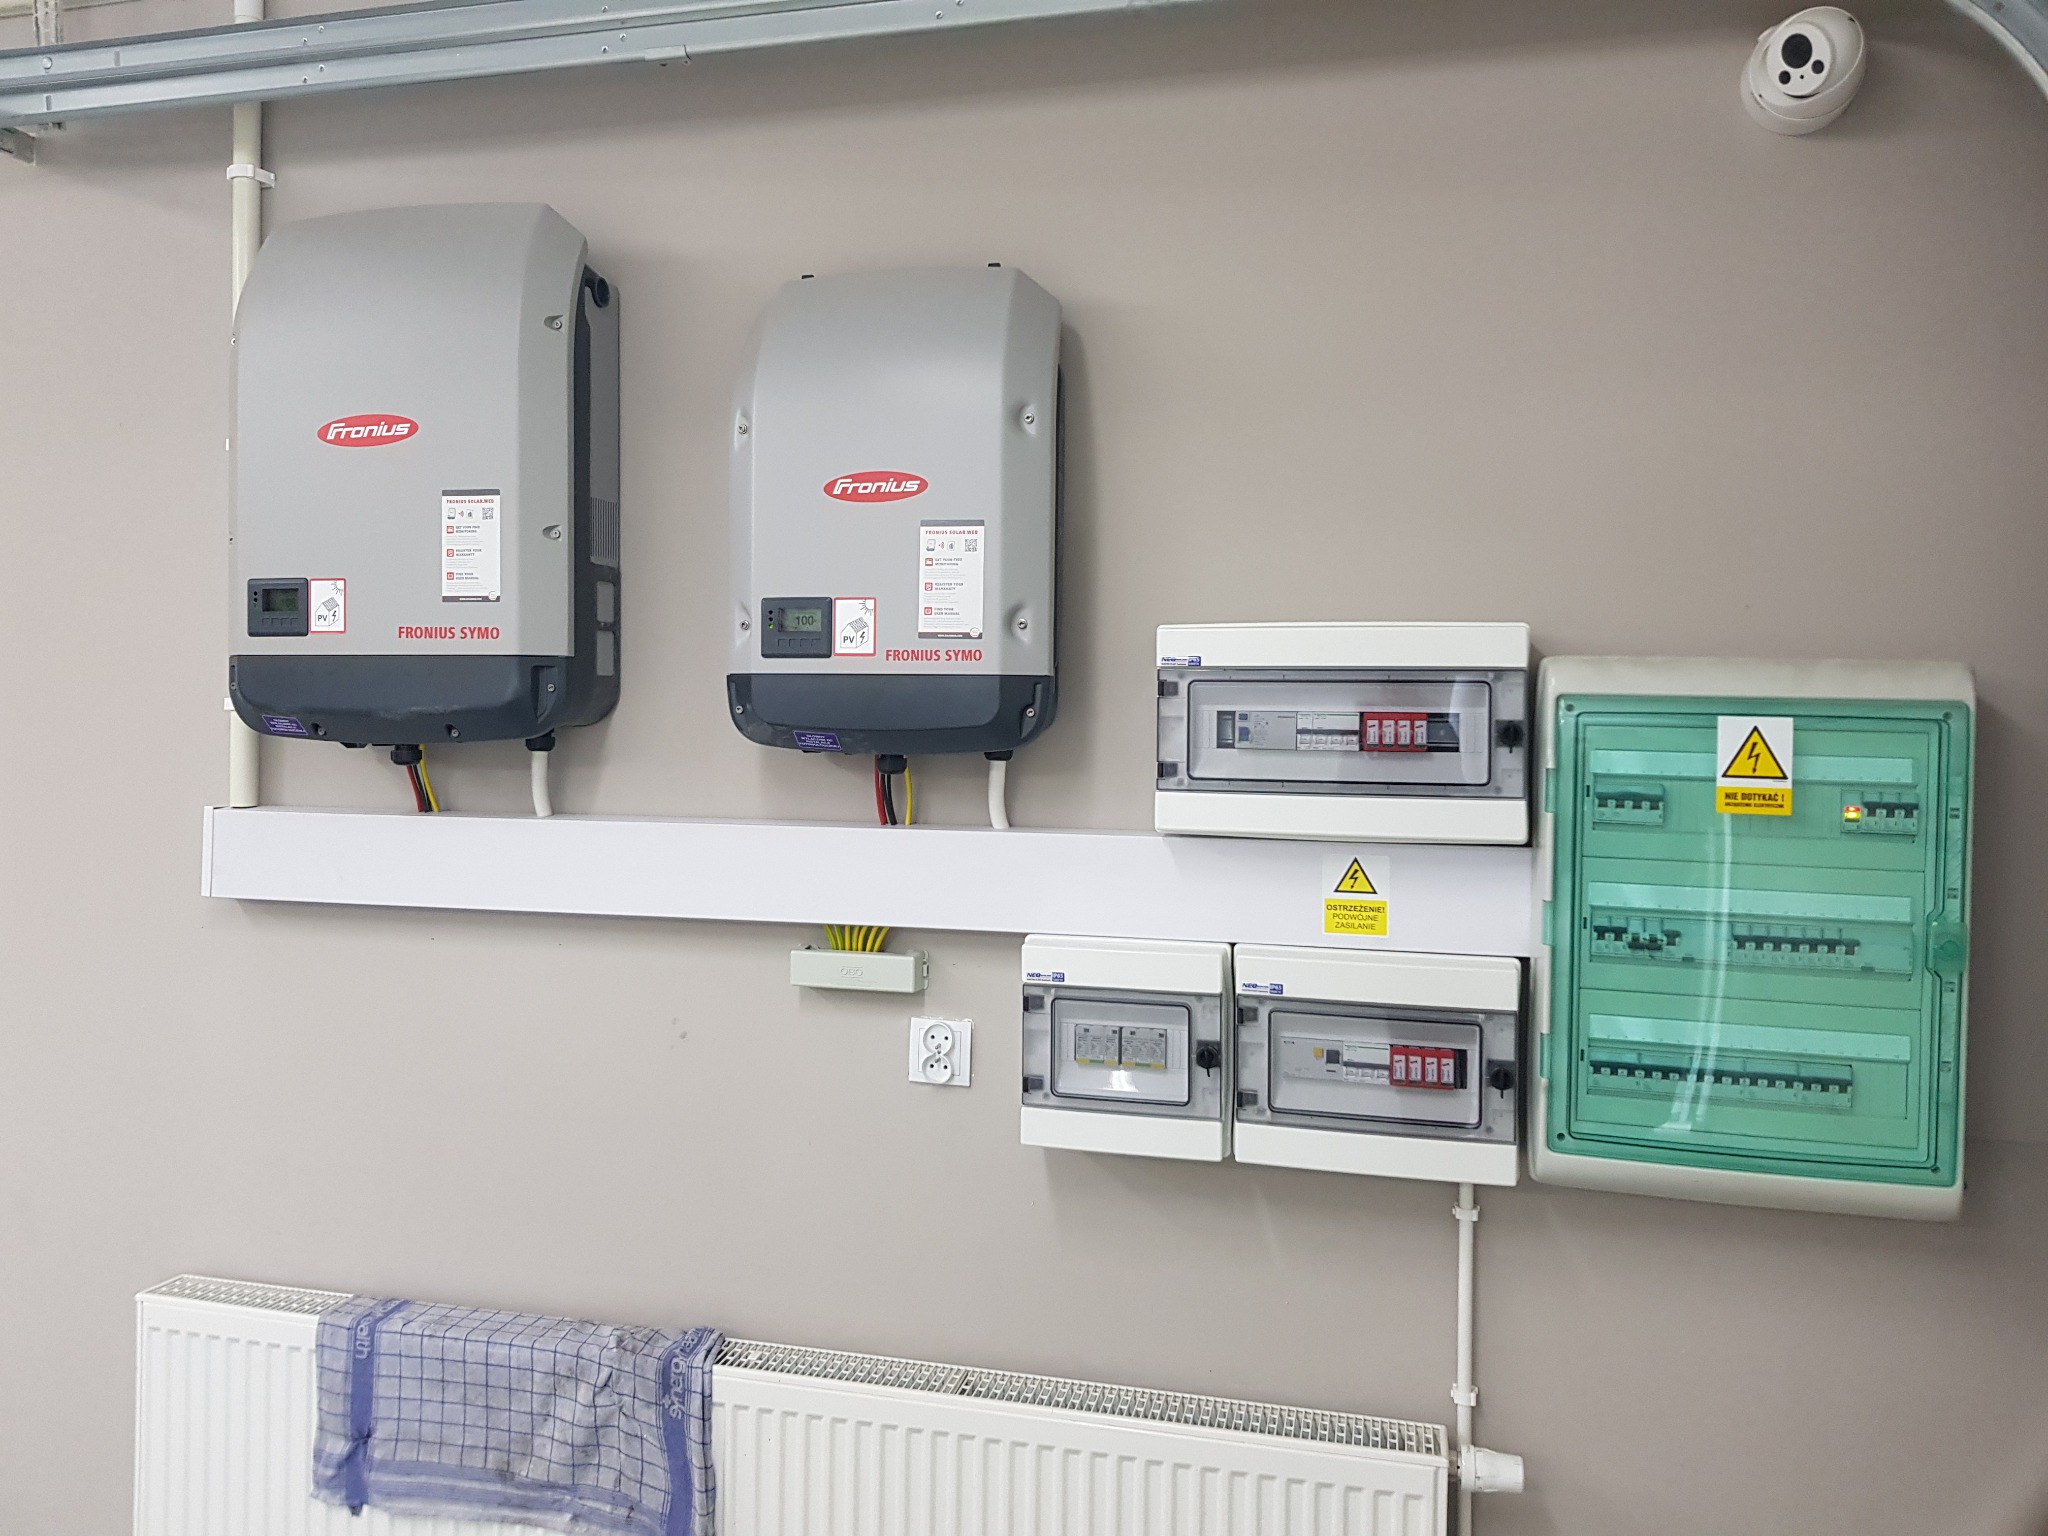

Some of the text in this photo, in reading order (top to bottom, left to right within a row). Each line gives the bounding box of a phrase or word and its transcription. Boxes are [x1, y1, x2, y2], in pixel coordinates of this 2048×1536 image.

[326, 421, 411, 440] Fronius
[832, 478, 920, 495] Fronius
[317, 614, 328, 622] PV
[795, 615, 814, 626] 100
[398, 626, 500, 640] FRONIUS SYMO
[843, 635, 855, 644] PV
[885, 649, 983, 661] FRONIUS SYMO
[1724, 792, 1739, 801] NIE
[1741, 791, 1779, 802] DOTYKAĆ
[1326, 904, 1385, 914] OSTRZEŻENIE!
[1332, 912, 1379, 922] PODWÓJNE
[1334, 921, 1377, 931] ZASILANIE
[840, 968, 864, 977] OBO
